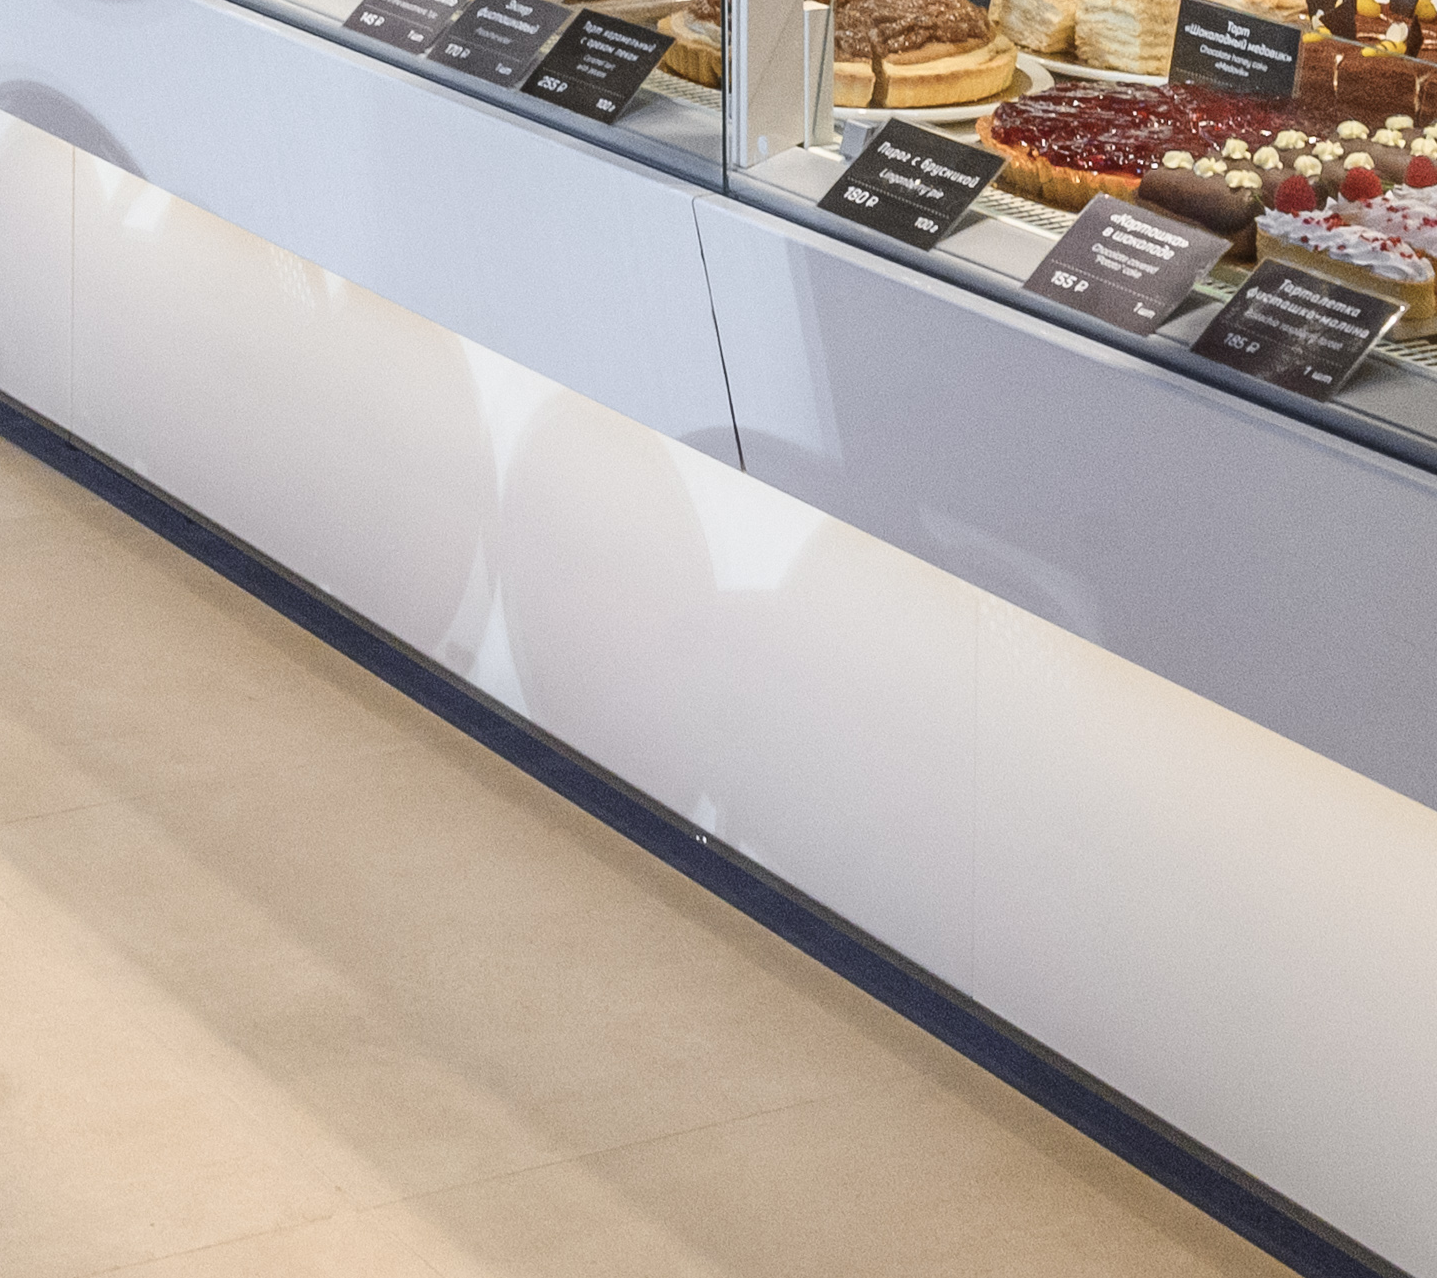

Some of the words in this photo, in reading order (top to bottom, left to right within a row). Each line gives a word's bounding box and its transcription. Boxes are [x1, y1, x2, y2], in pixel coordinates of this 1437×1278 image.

[583, 20, 604, 36] Торт
[1228, 20, 1250, 37] Торт
[1247, 43, 1292, 62] медовик»
[877, 140, 911, 163] Пирог
[921, 158, 981, 189] брусникой
[914, 217, 934, 230] 100
[1110, 213, 1189, 248] «Картошка»
[1112, 231, 1175, 260] шоколаде
[1051, 270, 1078, 288] 155
[1279, 278, 1362, 318] Тарталетка
[1246, 286, 1370, 339] фисташка-малина
[1224, 332, 1248, 350] 185
